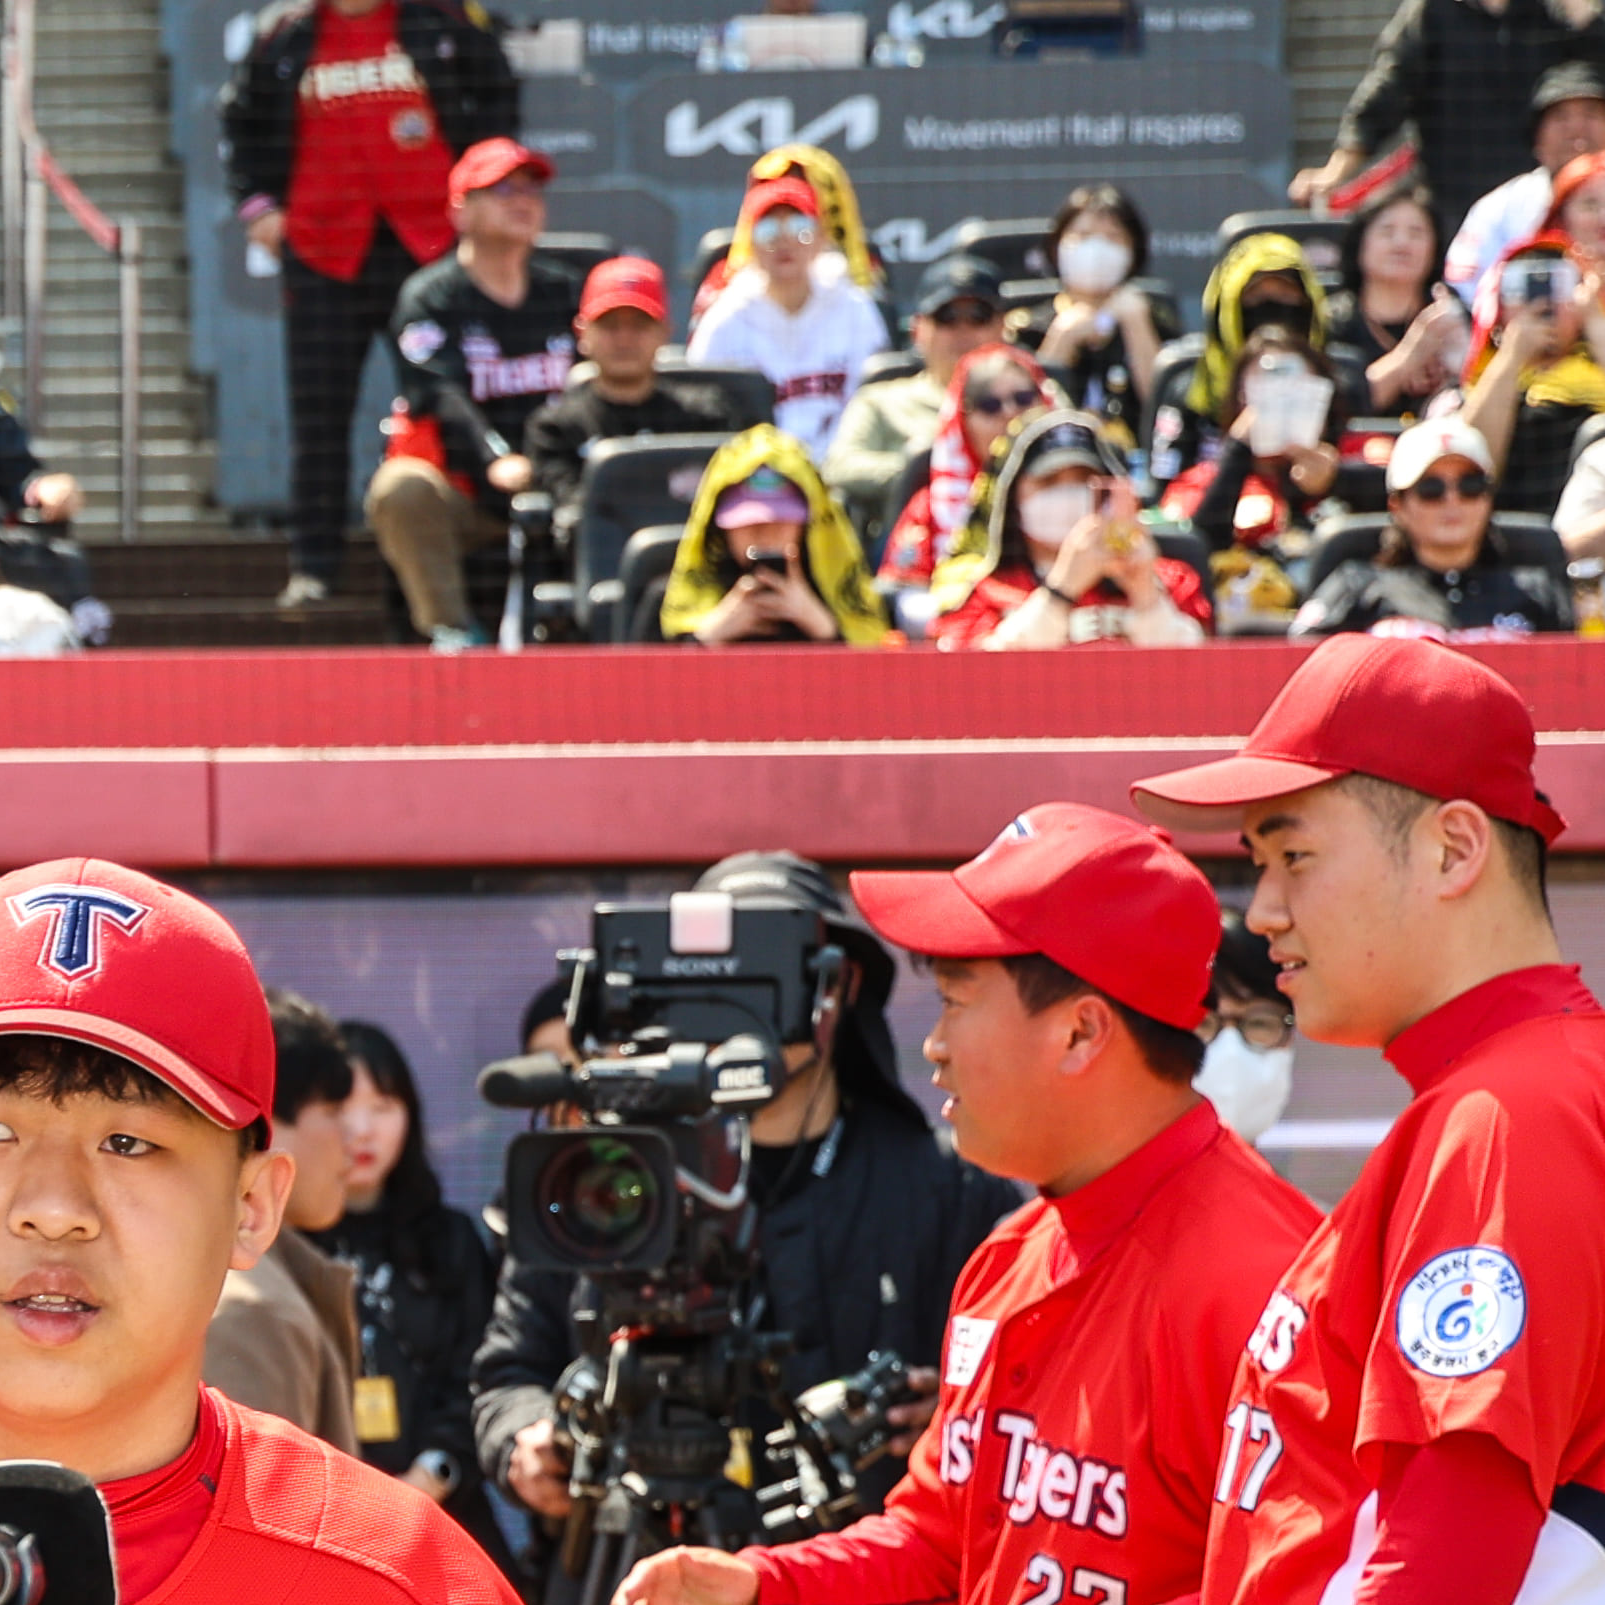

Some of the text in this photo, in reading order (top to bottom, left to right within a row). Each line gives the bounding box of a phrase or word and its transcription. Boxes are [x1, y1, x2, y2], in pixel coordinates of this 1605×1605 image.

[5, 883, 154, 984] T
[661, 956, 738, 976] SONY
[1214, 1401, 1285, 1513] 17
